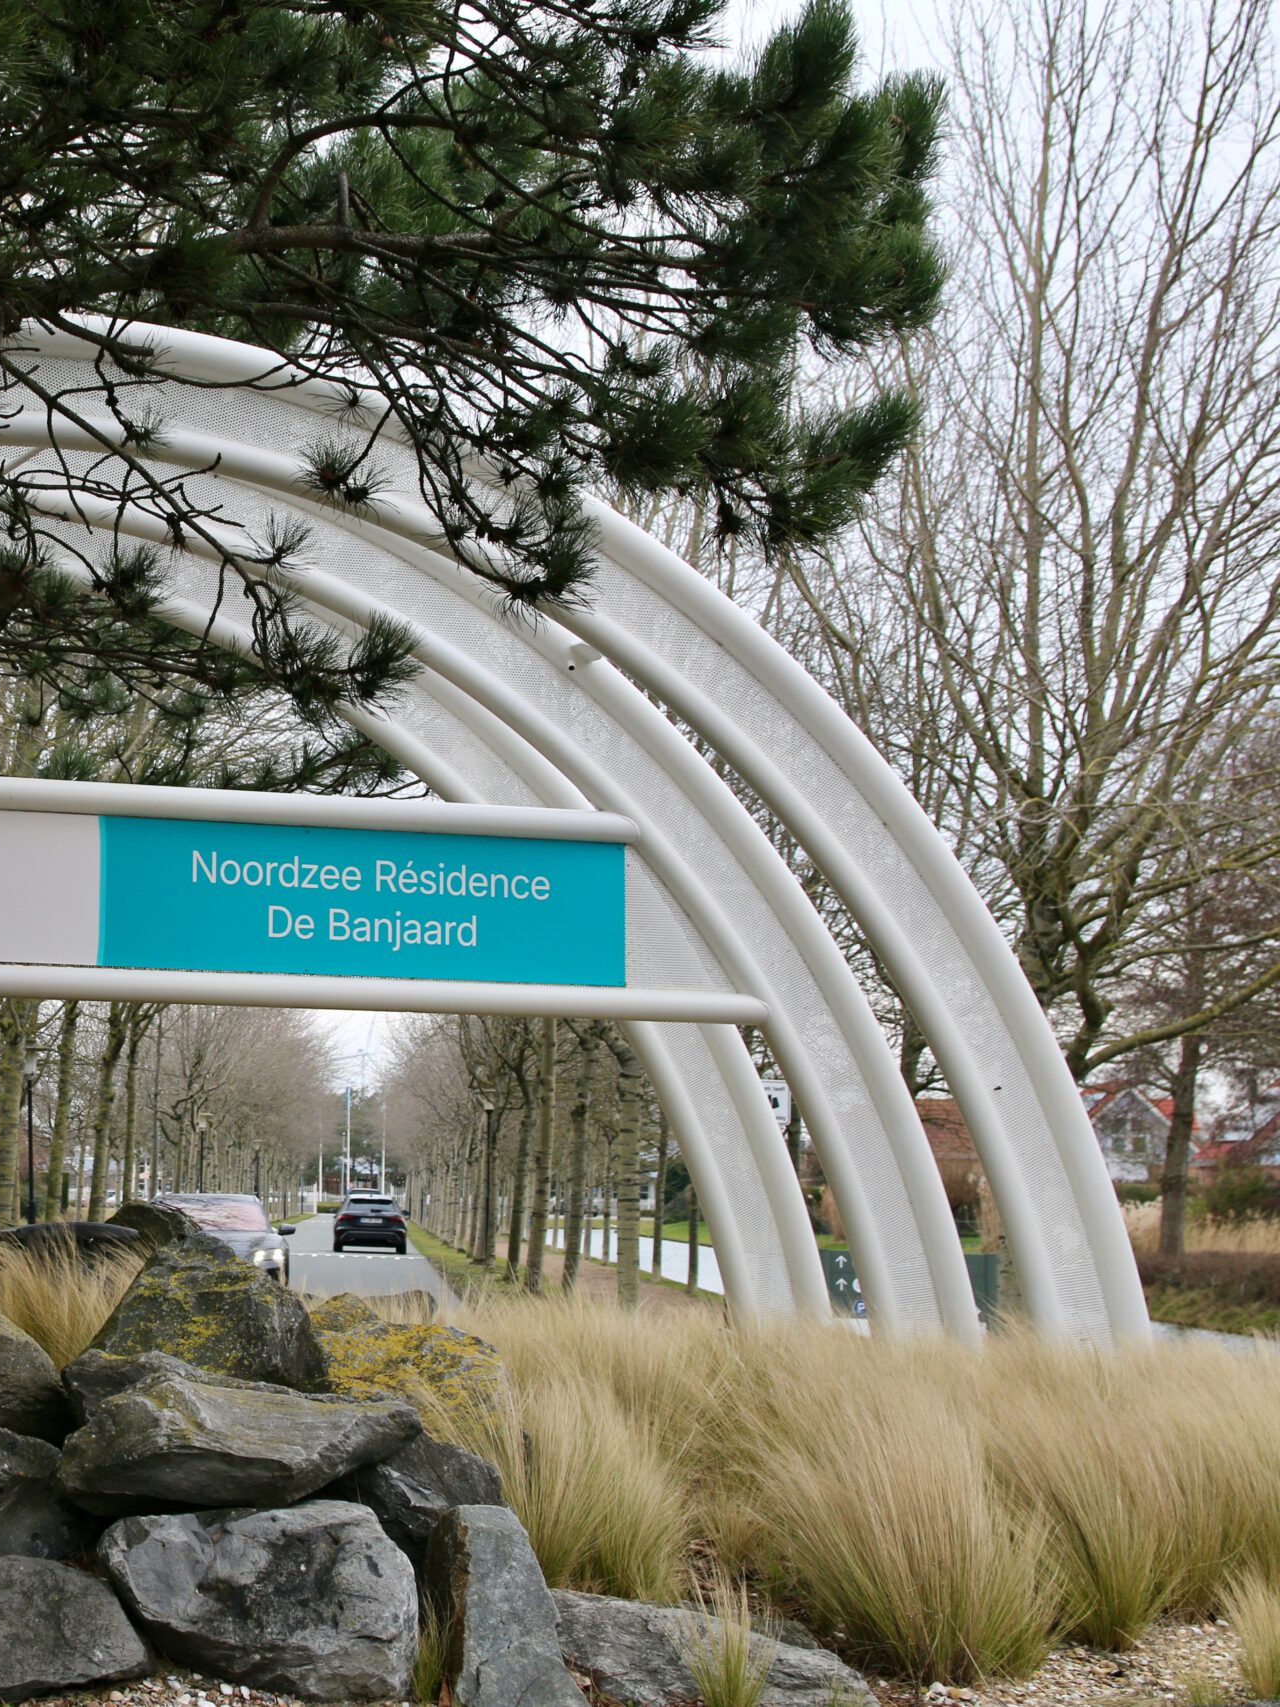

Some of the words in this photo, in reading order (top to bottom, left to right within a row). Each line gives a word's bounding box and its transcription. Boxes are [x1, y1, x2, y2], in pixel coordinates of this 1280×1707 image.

[192, 850, 362, 891] Noordzee
[375, 860, 551, 901] Résidence
[268, 905, 315, 940] De
[328, 908, 477, 952] Banjaard
